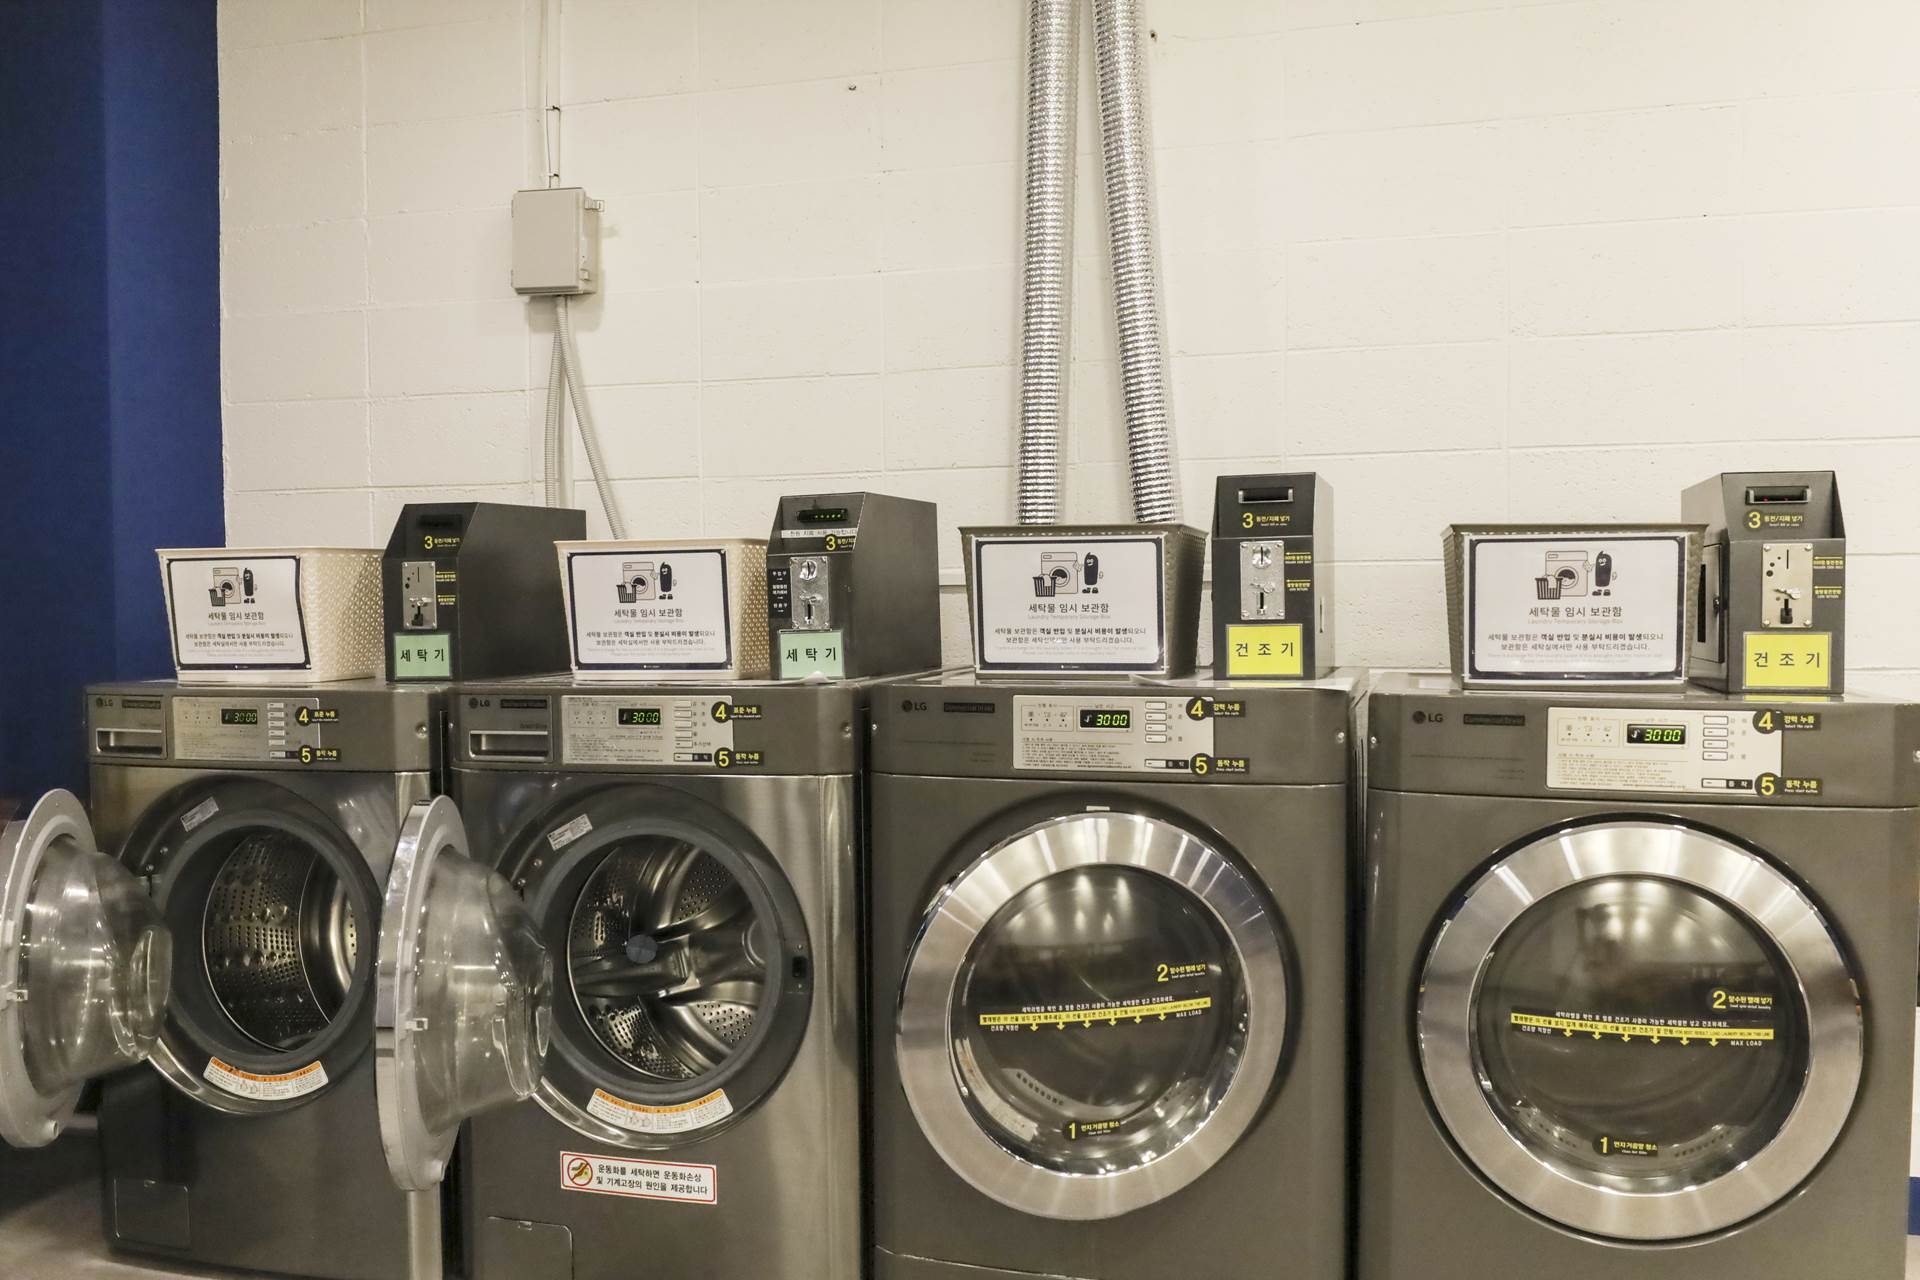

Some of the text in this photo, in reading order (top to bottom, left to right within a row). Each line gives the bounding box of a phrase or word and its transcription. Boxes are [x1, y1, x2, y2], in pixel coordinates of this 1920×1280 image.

[1242, 512, 1254, 528] 3
[1748, 512, 1760, 528] 3
[424, 536, 434, 550] 3
[826, 536, 836, 551] 3
[208, 612, 264, 620] 세탁물 임시 보관함
[614, 608, 682, 618] 세탁물 임시 보관함
[1029, 603, 1109, 613] 세탁물 임시 보관함
[1529, 607, 1622, 618] 세탁물 임시 보관함
[400, 648, 444, 662] 세탁기
[786, 648, 836, 662] 세탁기
[1236, 642, 1294, 658] 건조기
[1754, 652, 1820, 668] 건조기
[716, 704, 726, 720] 4
[914, 702, 927, 710] LG
[1190, 700, 1204, 717] 4
[298, 708, 309, 723] 4
[1428, 713, 1444, 722] LG
[1758, 712, 1773, 730] 4
[302, 748, 311, 763] 5
[718, 751, 729, 767] 5
[1196, 757, 1208, 774] 5
[1761, 776, 1775, 796] 5
[1156, 964, 1169, 982] 2
[1713, 990, 1726, 1009] 2
[1068, 1122, 1076, 1140] 1
[1600, 1136, 1608, 1154] 1
[598, 1164, 702, 1182] 운동화를 세탁하면 운동화손상
[596, 1176, 708, 1194] 및 기계고장의 원인을 제공합니다
